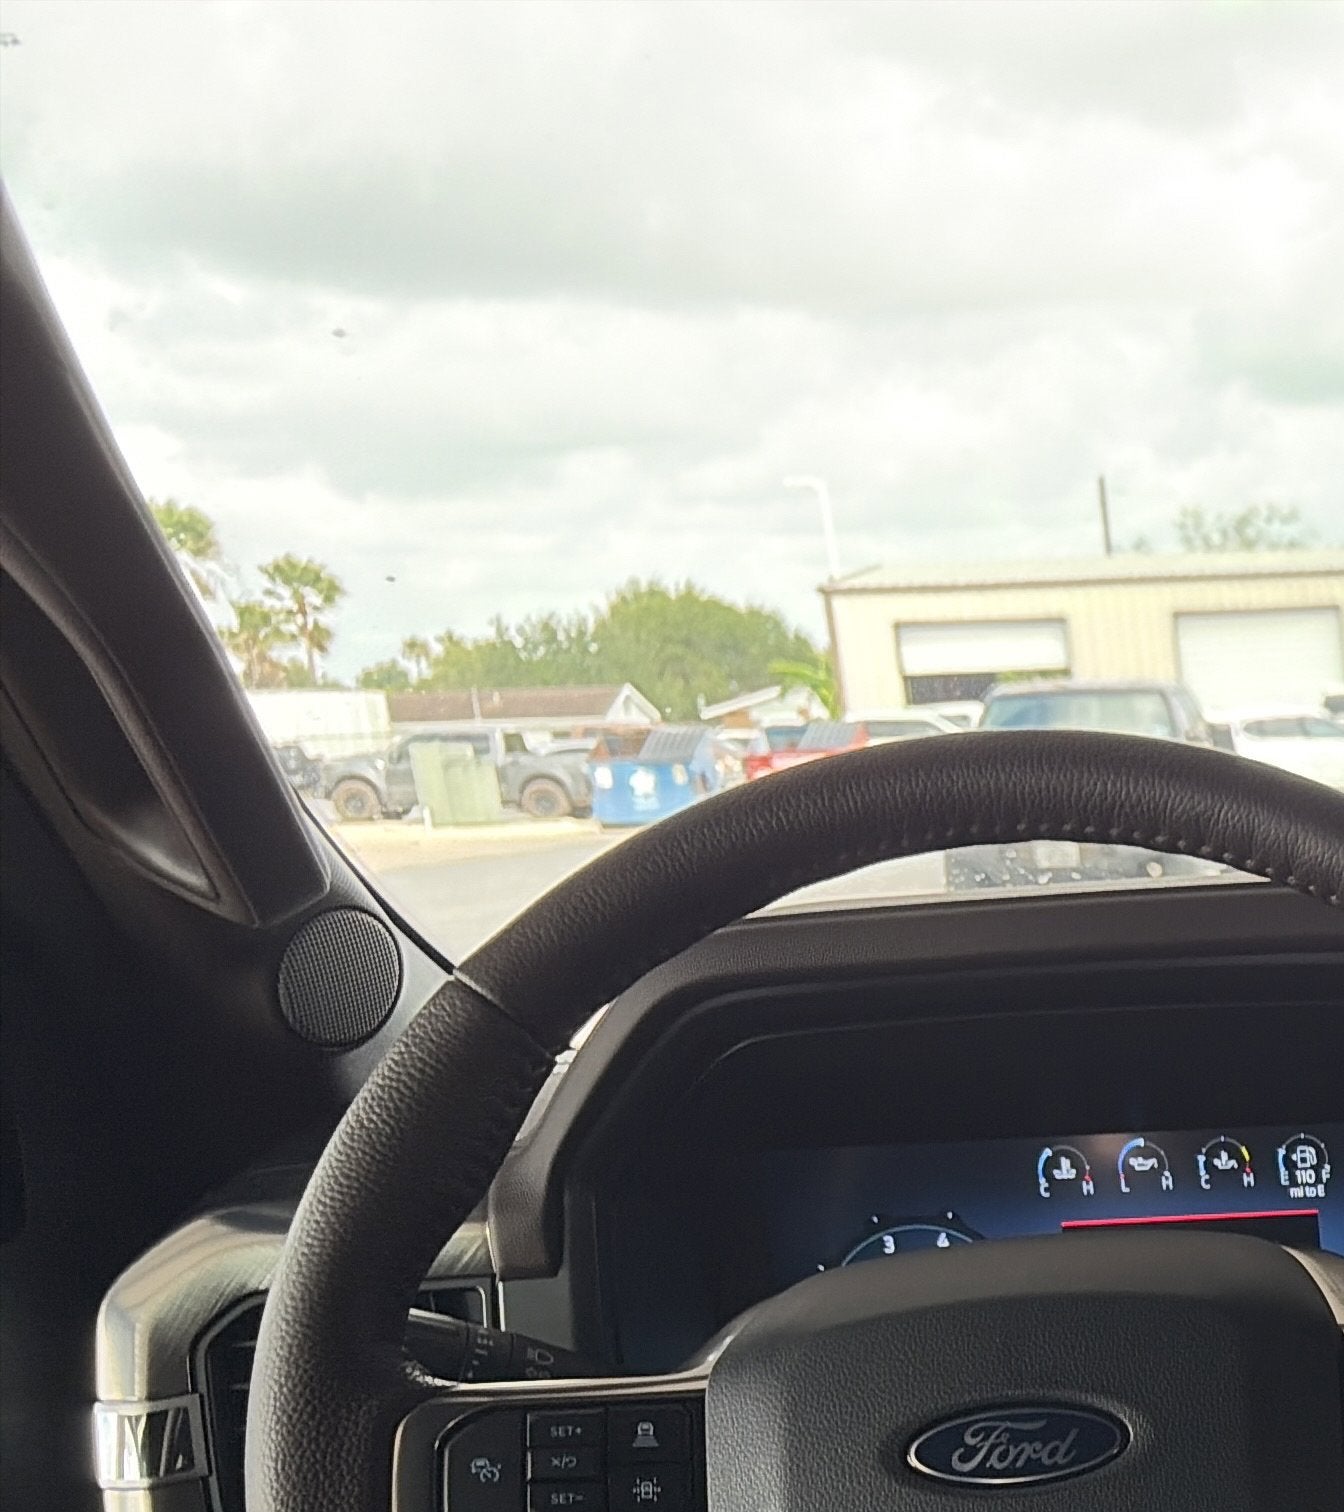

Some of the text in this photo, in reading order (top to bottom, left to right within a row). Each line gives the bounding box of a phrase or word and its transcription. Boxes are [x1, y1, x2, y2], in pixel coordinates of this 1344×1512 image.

[1161, 1175, 1173, 1190] H
[1200, 1173, 1211, 1189] C
[1243, 1173, 1255, 1187] H
[1280, 1172, 1290, 1186] E
[1295, 1169, 1316, 1185] 110
[1321, 1167, 1331, 1183] F
[1040, 1182, 1051, 1199] C
[1082, 1180, 1094, 1196] H
[1120, 1178, 1130, 1193] L
[882, 1234, 895, 1255] 3
[951, 1419, 1080, 1473] Ford
